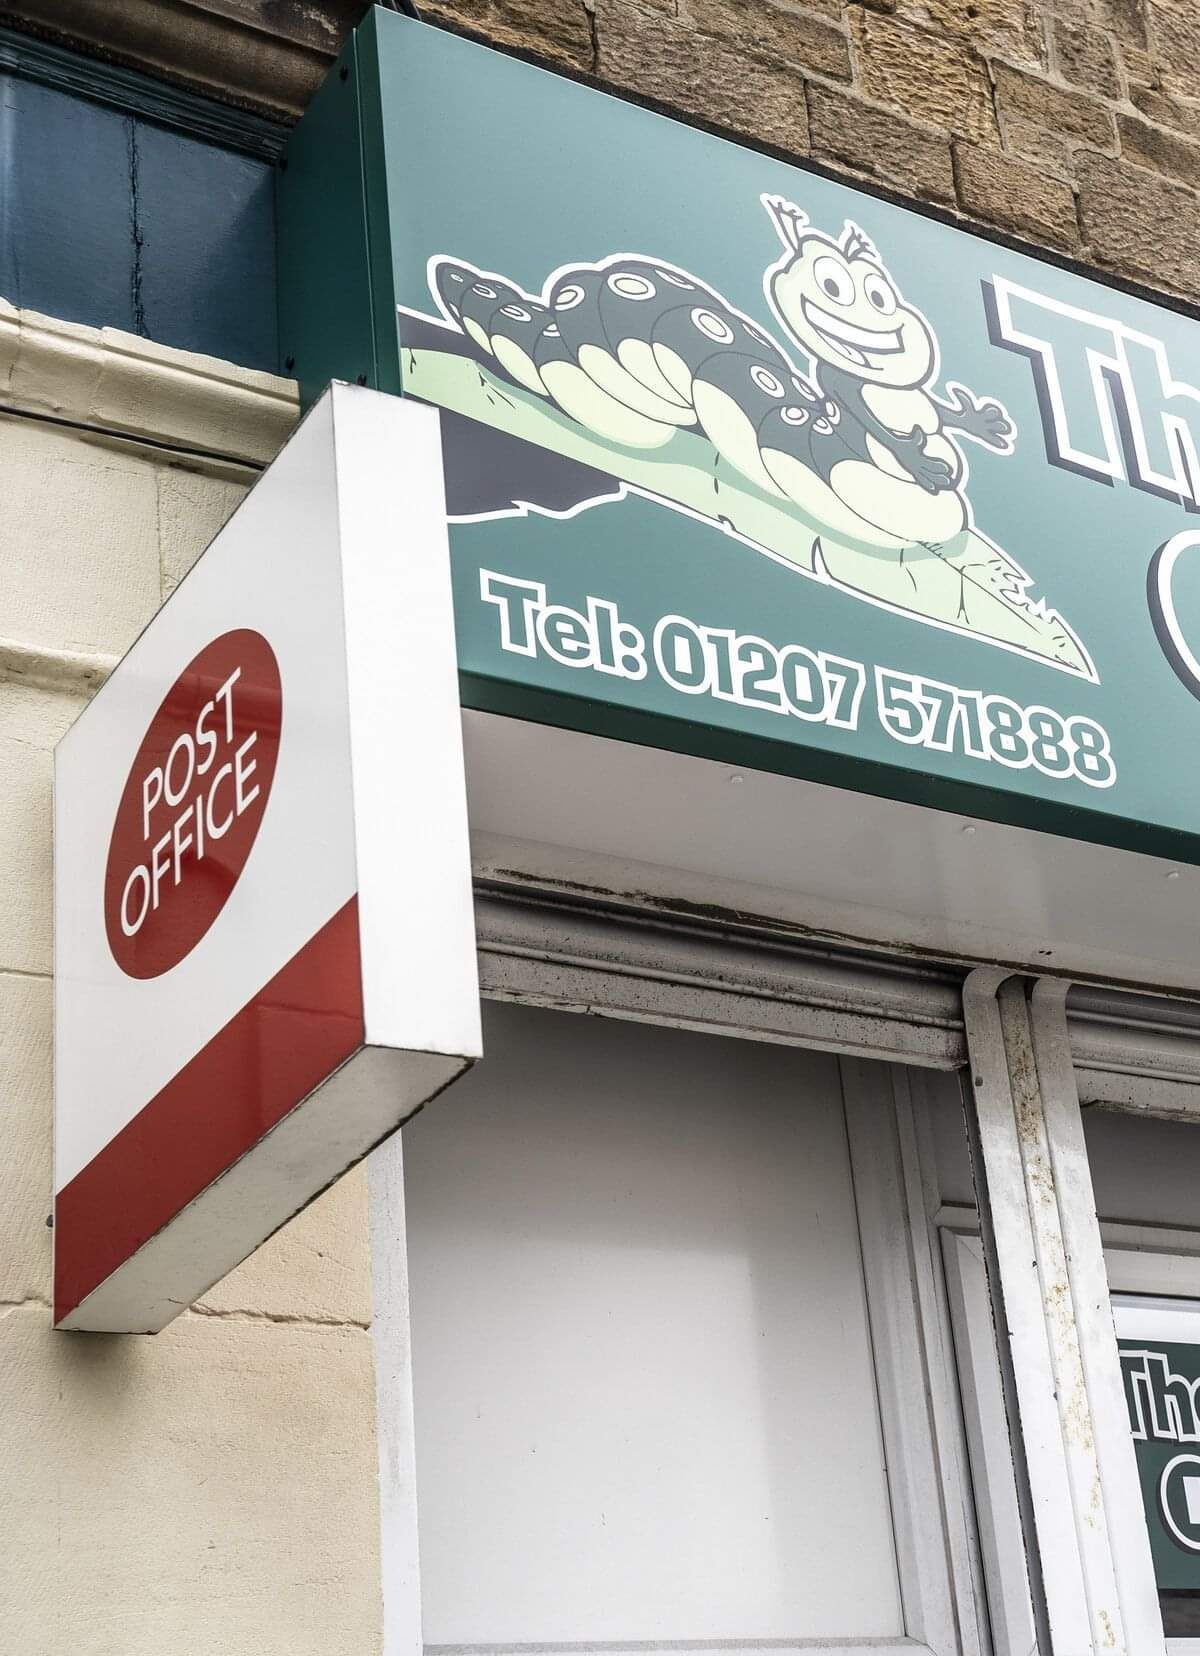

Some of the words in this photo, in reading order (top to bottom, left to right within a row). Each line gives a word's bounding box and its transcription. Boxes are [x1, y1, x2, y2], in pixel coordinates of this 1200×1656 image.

[143, 667, 242, 841] POST
[479, 569, 648, 682] Tel:
[653, 614, 866, 731] 01207
[875, 666, 1117, 788] 571888
[120, 731, 260, 936] OFFICE
